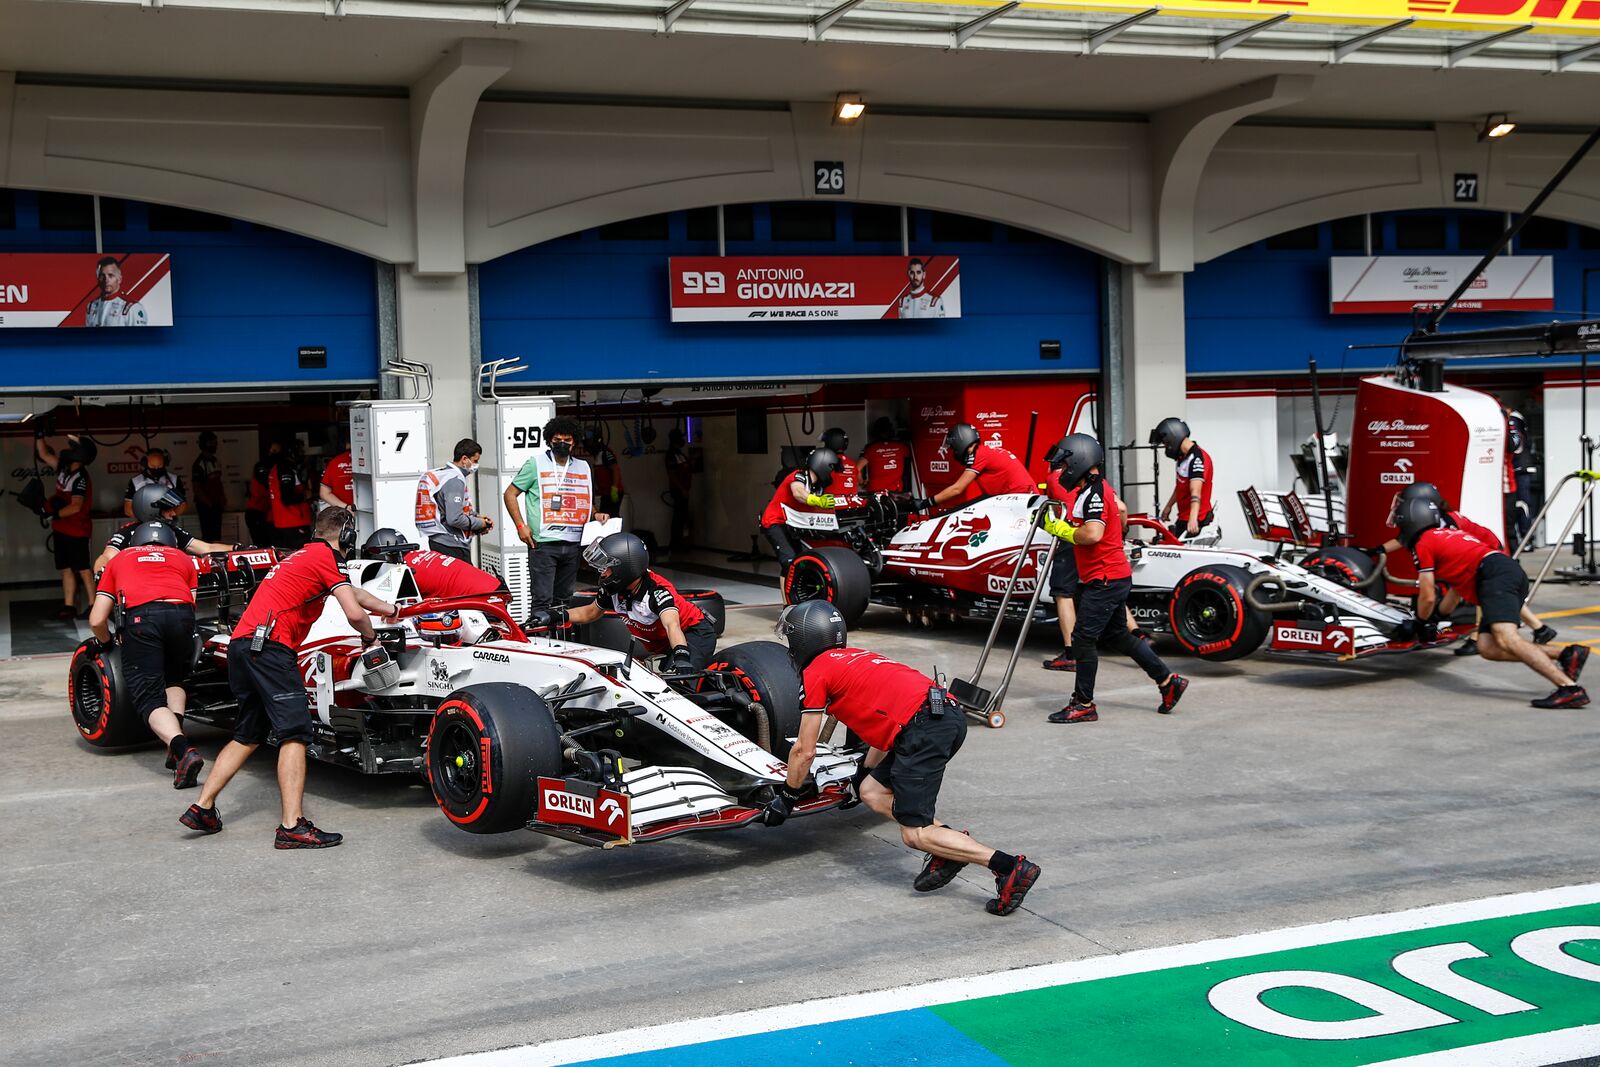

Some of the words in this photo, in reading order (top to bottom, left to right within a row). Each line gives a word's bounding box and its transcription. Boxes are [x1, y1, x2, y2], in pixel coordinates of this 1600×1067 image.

[816, 167, 844, 190] 26
[1455, 179, 1477, 198] 27
[736, 267, 804, 281] ANTONIO
[682, 271, 726, 294] 99
[737, 282, 855, 300] GIOVINAZZI
[769, 310, 784, 318] WE
[1367, 420, 1390, 435] Alfa
[1390, 419, 1430, 431] Romeo
[395, 432, 409, 452] 7
[513, 426, 542, 449] 99
[1380, 440, 1415, 448] RACING
[931, 462, 948, 471] ORLEN
[1382, 474, 1411, 482] ORLEN
[1147, 550, 1182, 559] CARRERA
[990, 577, 1036, 592] OREN
[1281, 629, 1319, 642] ORLEN
[472, 650, 510, 663] CARRERA
[427, 681, 455, 691] SINGHA
[731, 666, 761, 702] ZER
[666, 721, 688, 739] Additive
[685, 735, 710, 755] Industries
[548, 793, 592, 815] ORLEN
